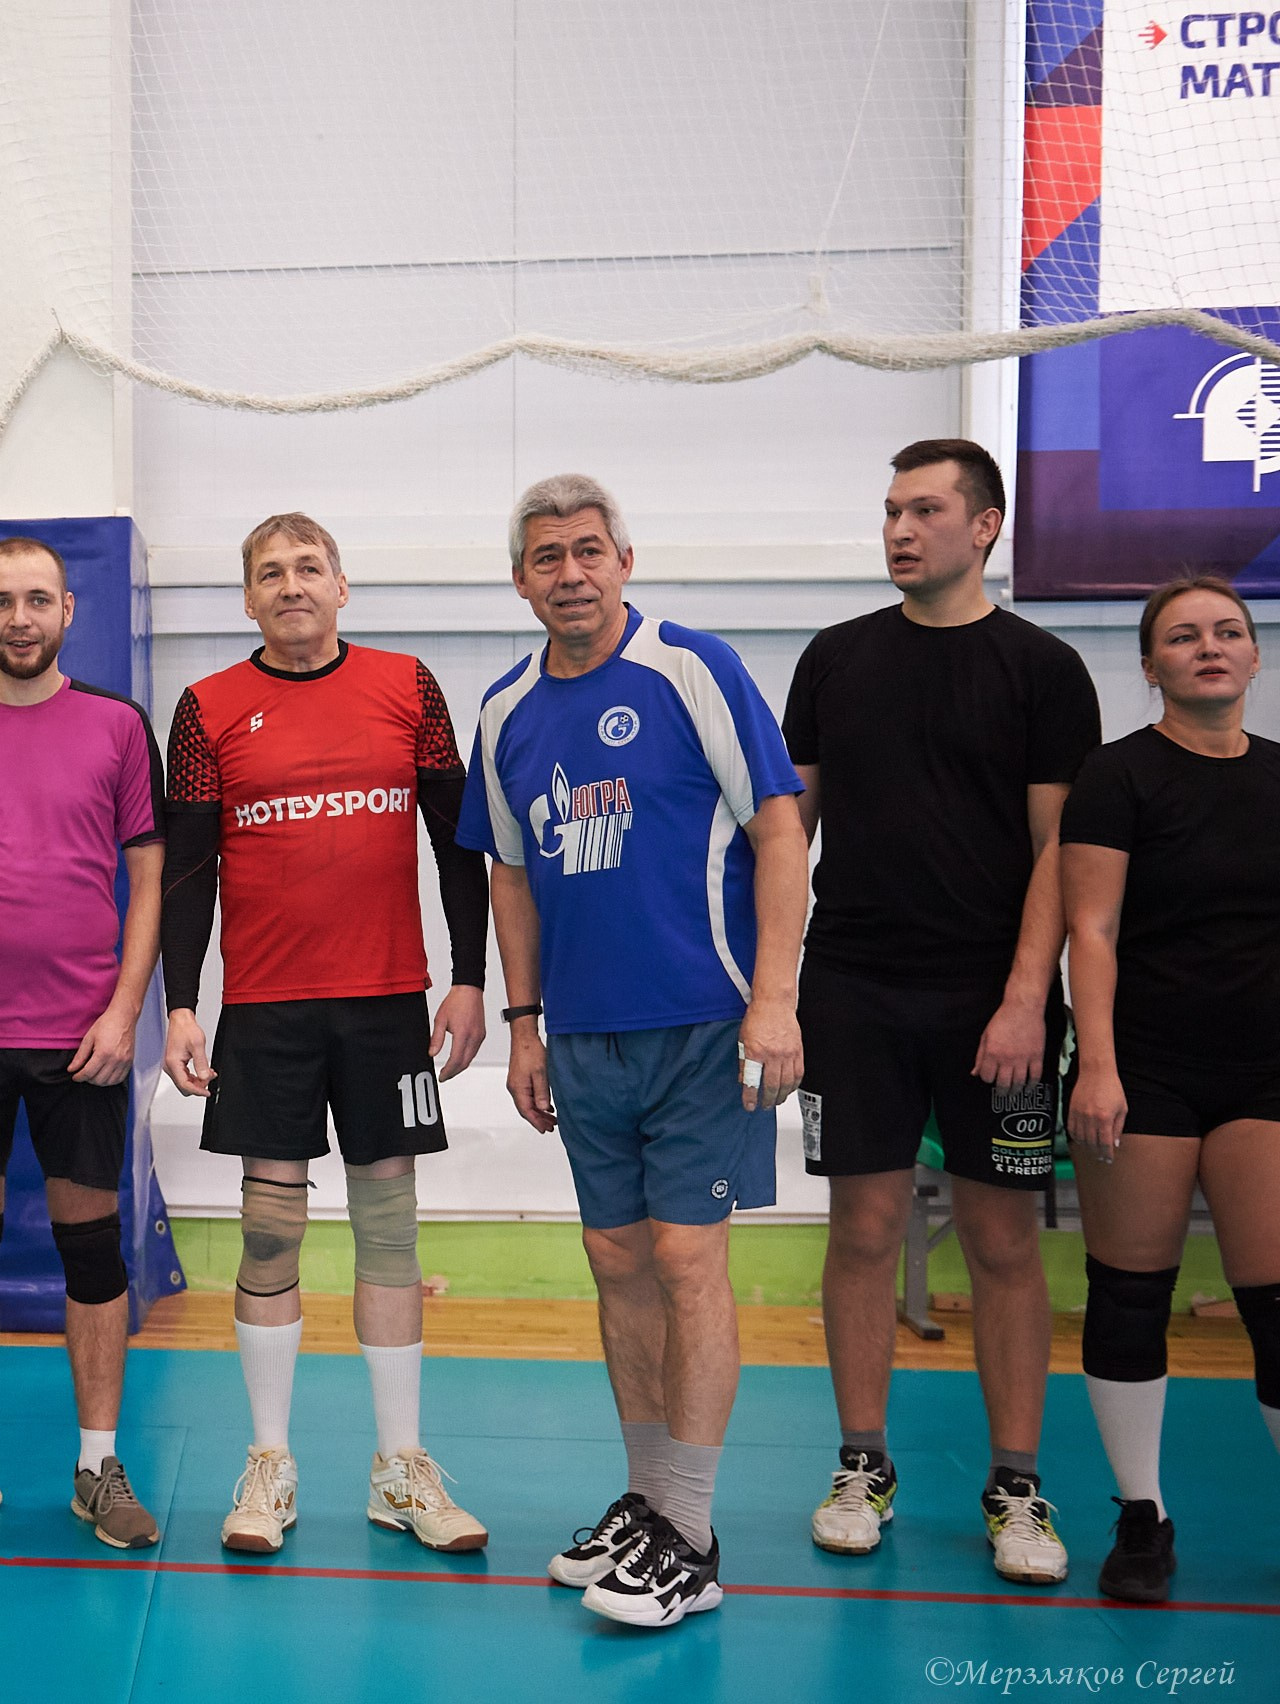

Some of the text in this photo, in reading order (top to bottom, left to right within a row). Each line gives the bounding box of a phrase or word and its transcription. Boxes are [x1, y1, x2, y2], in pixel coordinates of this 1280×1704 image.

[234, 787, 410, 828] HOTEYSPORT
[572, 777, 633, 820] ЮГРА
[397, 1071, 438, 1128] 10
[1016, 1119, 1044, 1133] 001
[995, 1164, 1004, 1172] &
